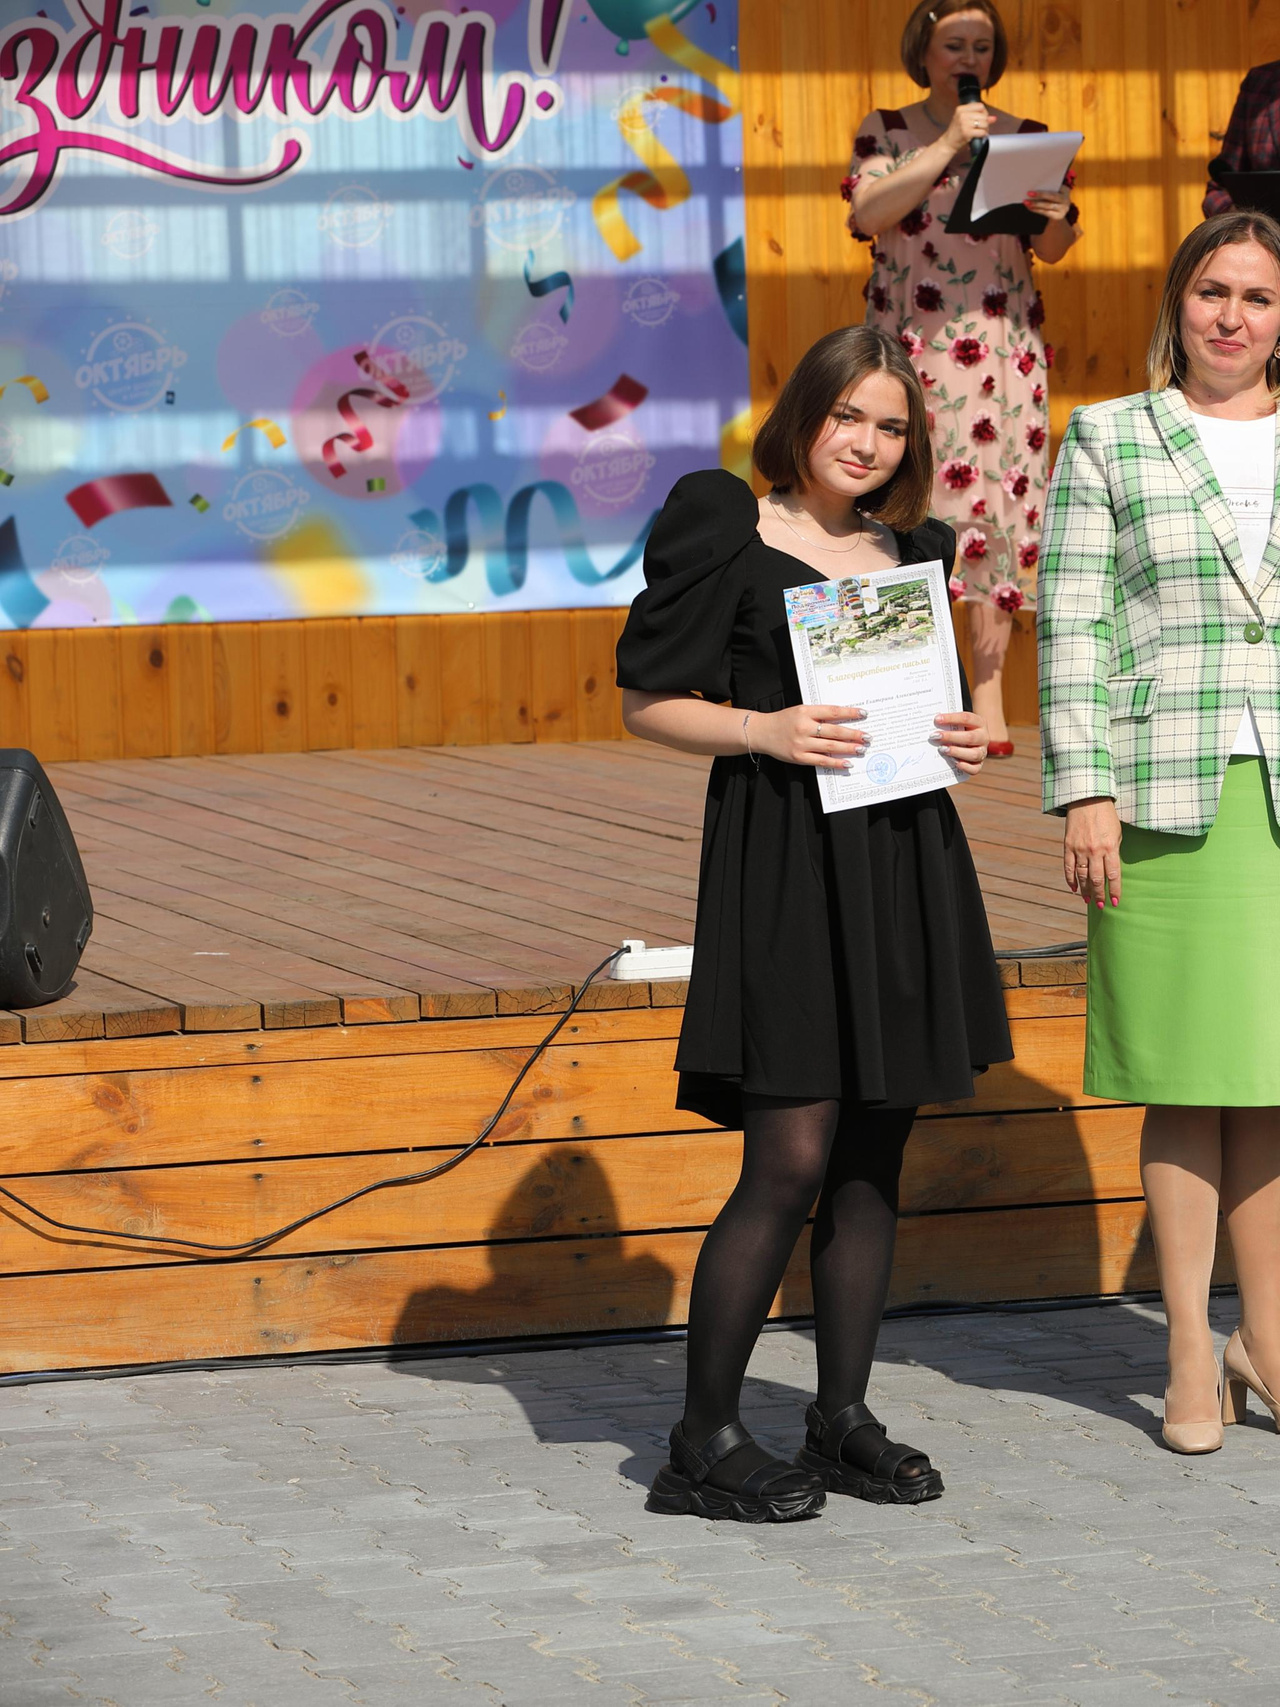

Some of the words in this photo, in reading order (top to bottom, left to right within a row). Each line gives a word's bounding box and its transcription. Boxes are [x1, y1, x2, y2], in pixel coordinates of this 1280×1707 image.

[468, 186, 577, 228] ОКТЯБРЬ
[75, 344, 189, 389] ОКТЯБРЬ
[571, 451, 656, 485] ОКТЯБРЬ
[223, 486, 311, 521] ОКТЯБРЬ
[827, 664, 901, 684] Благодарственное
[902, 658, 931, 669] письмо
